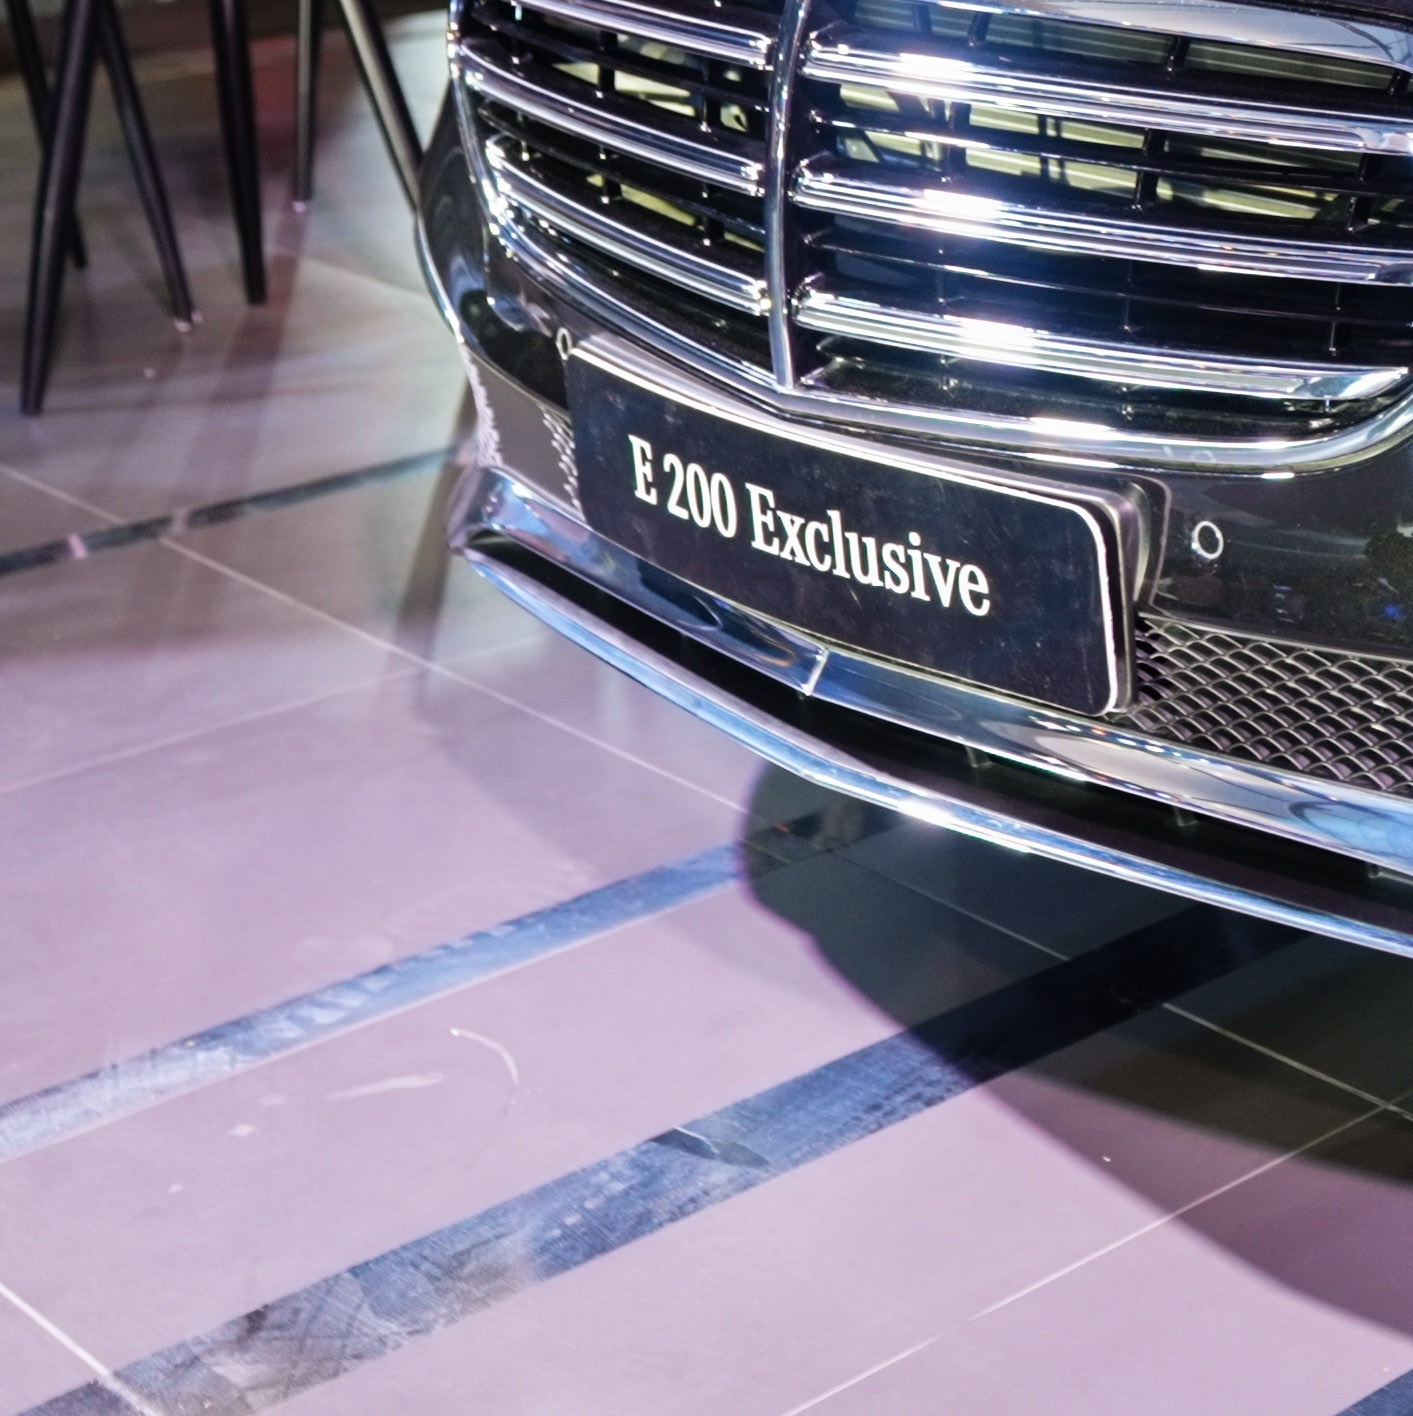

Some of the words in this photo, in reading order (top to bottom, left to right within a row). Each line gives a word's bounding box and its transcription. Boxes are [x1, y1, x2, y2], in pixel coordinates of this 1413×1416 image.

[627, 433, 658, 506] E
[663, 452, 738, 539] 200
[744, 482, 992, 618] Exclusive
